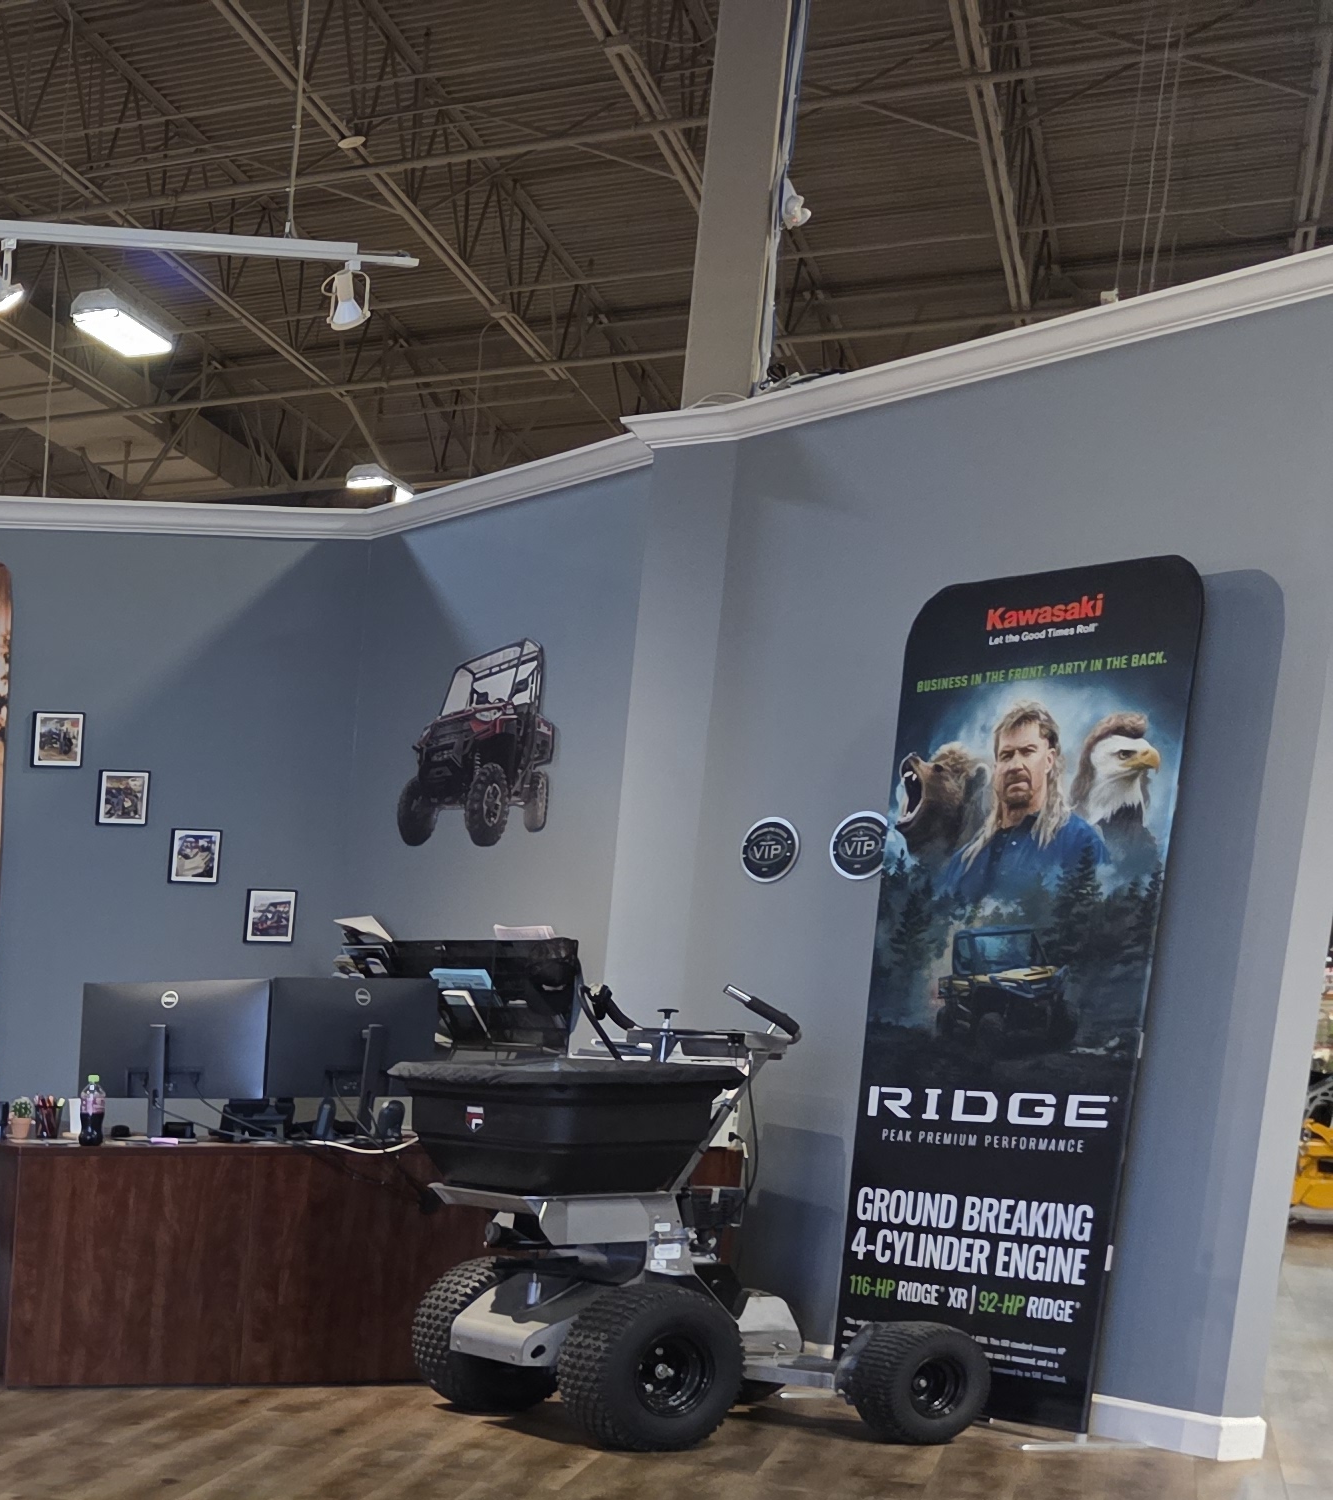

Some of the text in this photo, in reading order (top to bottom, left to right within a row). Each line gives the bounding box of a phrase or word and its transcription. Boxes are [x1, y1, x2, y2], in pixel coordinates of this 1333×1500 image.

[986, 593, 1104, 631] Kawasaki
[989, 636, 1003, 646] Let
[1005, 633, 1020, 644] the
[1021, 629, 1045, 642] Good
[1047, 626, 1075, 638] Times
[916, 651, 1168, 693] BUSINESS IN THE FRONT. PARTY IN THE BACK.
[753, 844, 782, 859] VIP
[844, 840, 875, 856] VIP
[867, 1085, 1112, 1129] RIDGE
[882, 1128, 1084, 1153] PEAK PREMIUM PERFORMANCE
[856, 1186, 1094, 1242] GROUND BREAKING
[851, 1227, 1090, 1286] 4-CYLINDER ENGINE
[849, 1274, 896, 1299] 116-HP
[948, 1286, 968, 1310] XR
[978, 1291, 1026, 1316] 92-HP
